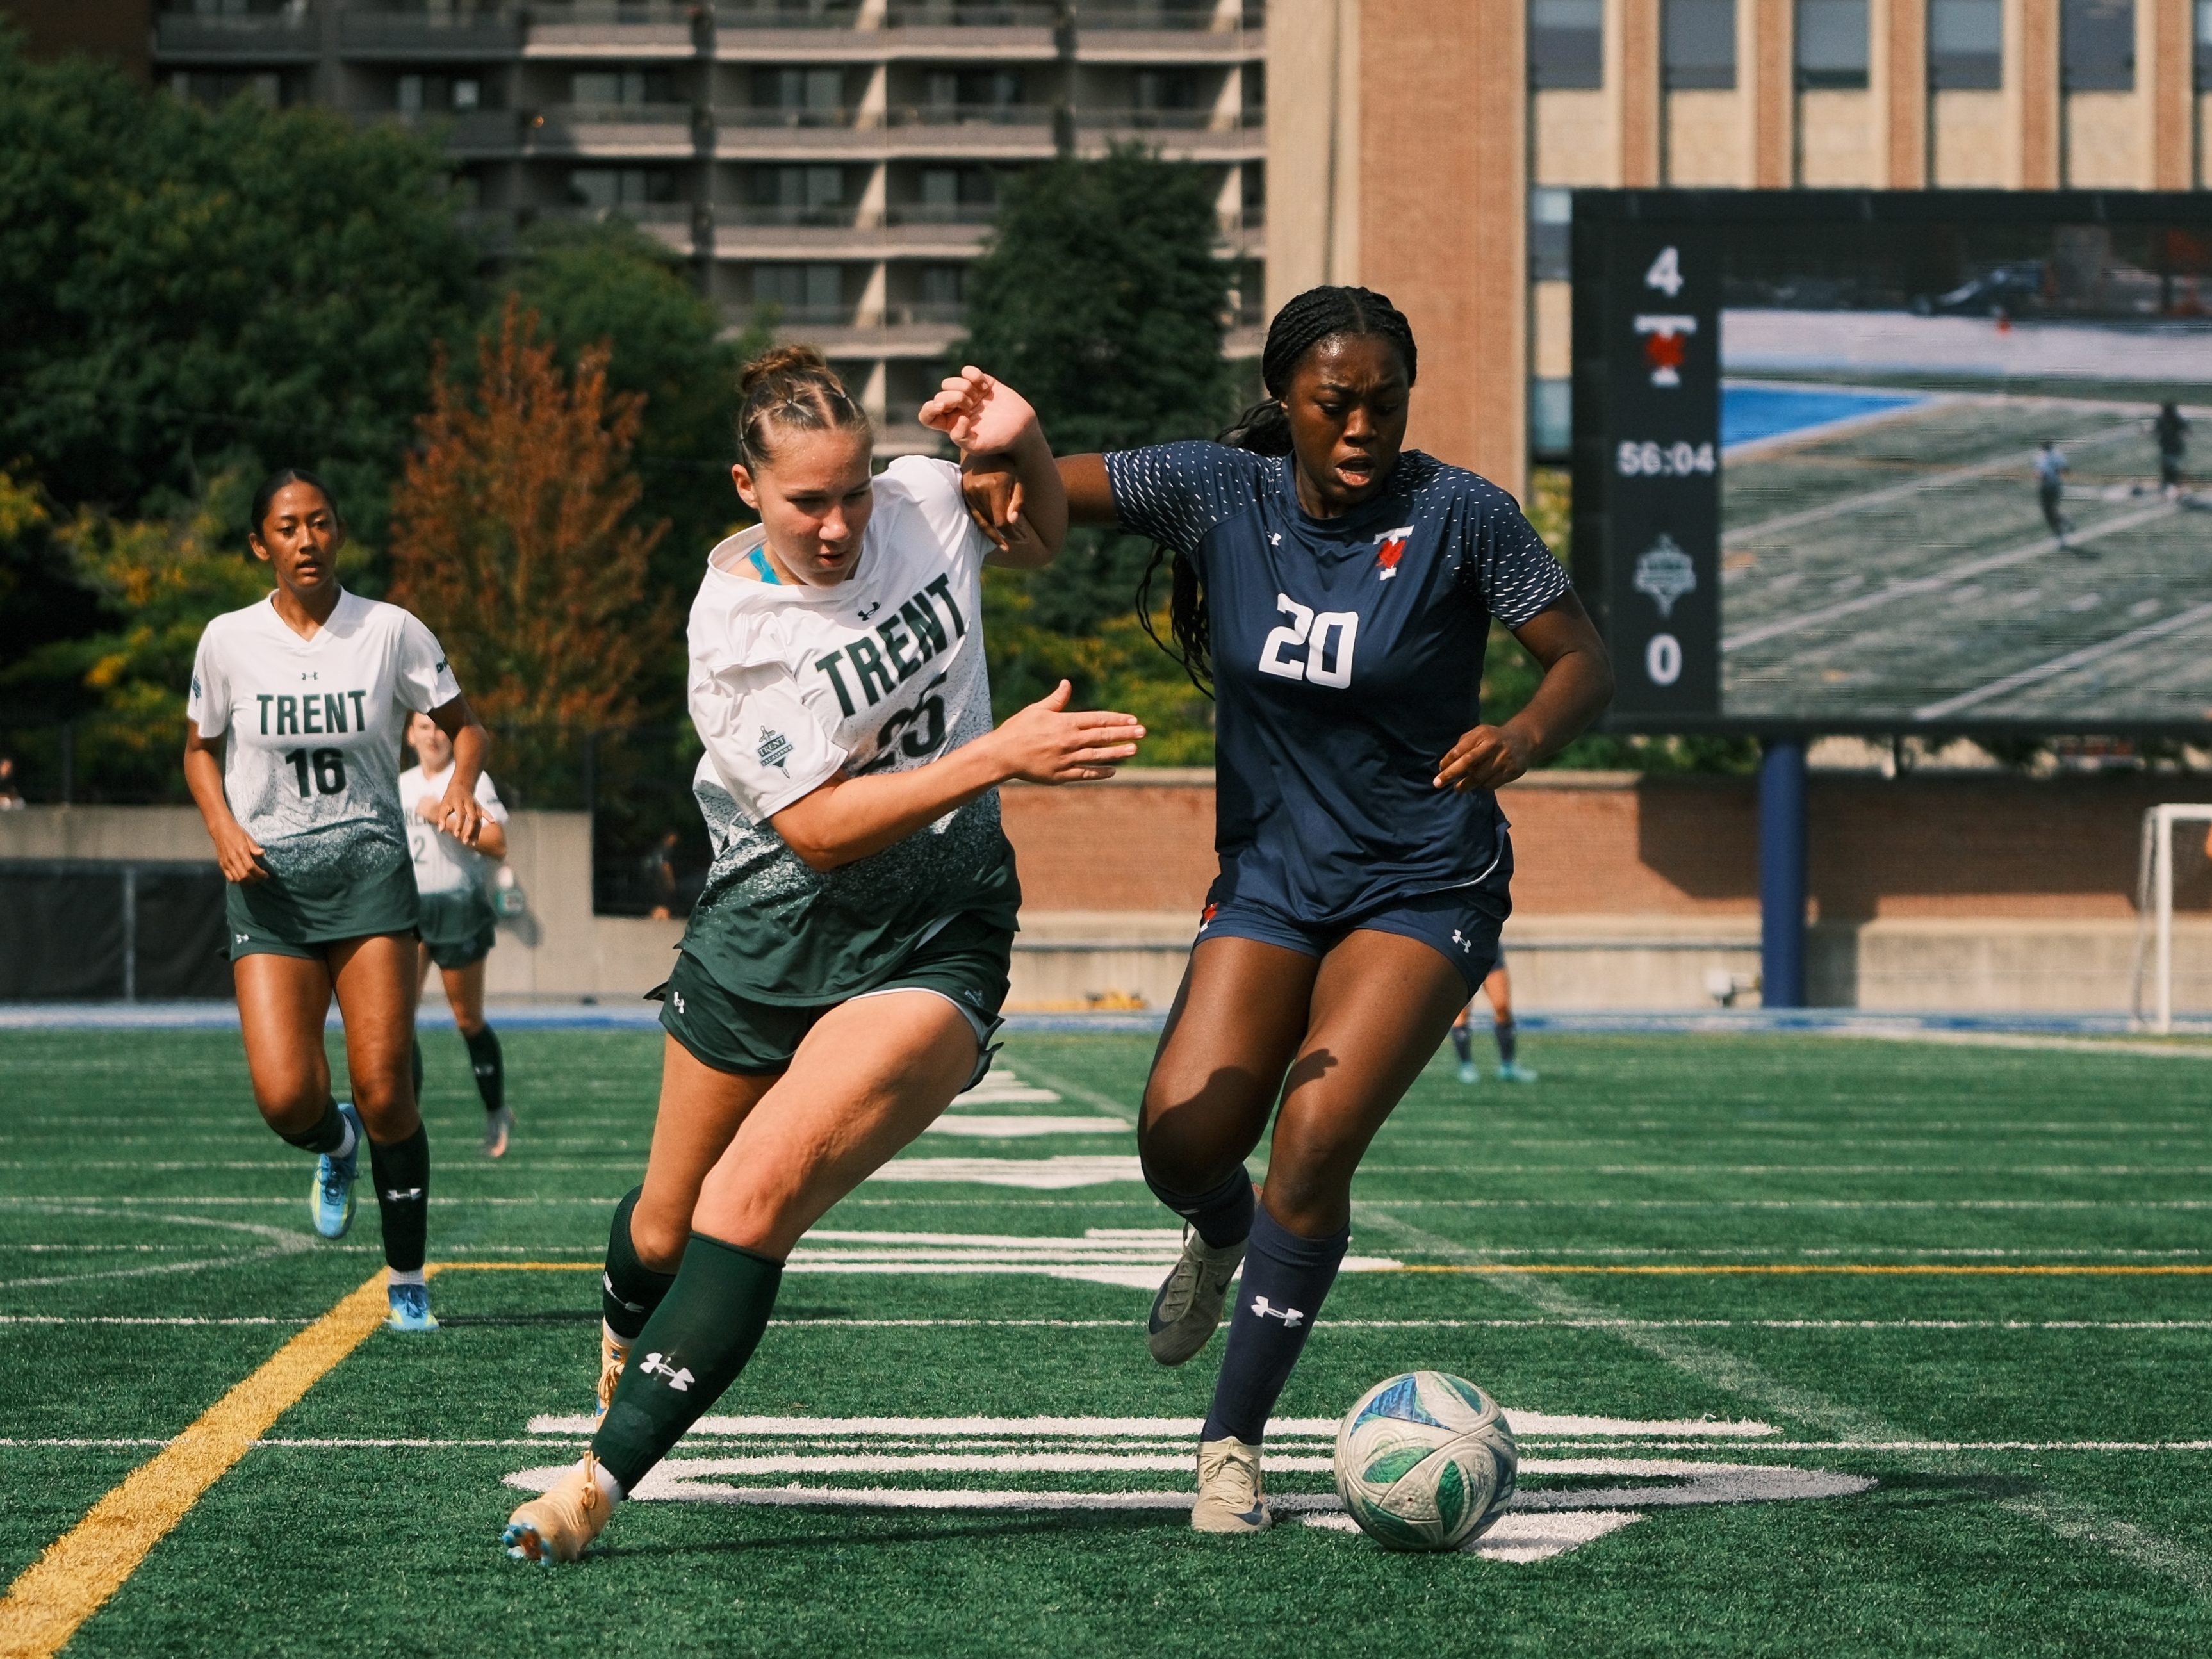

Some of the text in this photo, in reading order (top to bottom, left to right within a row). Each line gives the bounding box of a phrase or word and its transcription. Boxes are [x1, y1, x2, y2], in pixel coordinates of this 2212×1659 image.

[1644, 246, 1684, 297] 4
[1617, 440, 1716, 476] 56:04
[815, 572, 966, 718] TRENT
[1258, 592, 1359, 689] 20
[1645, 633, 1683, 686] 0
[257, 689, 367, 735] TRENT
[758, 737, 785, 755] TRENT
[286, 748, 347, 799] 16
